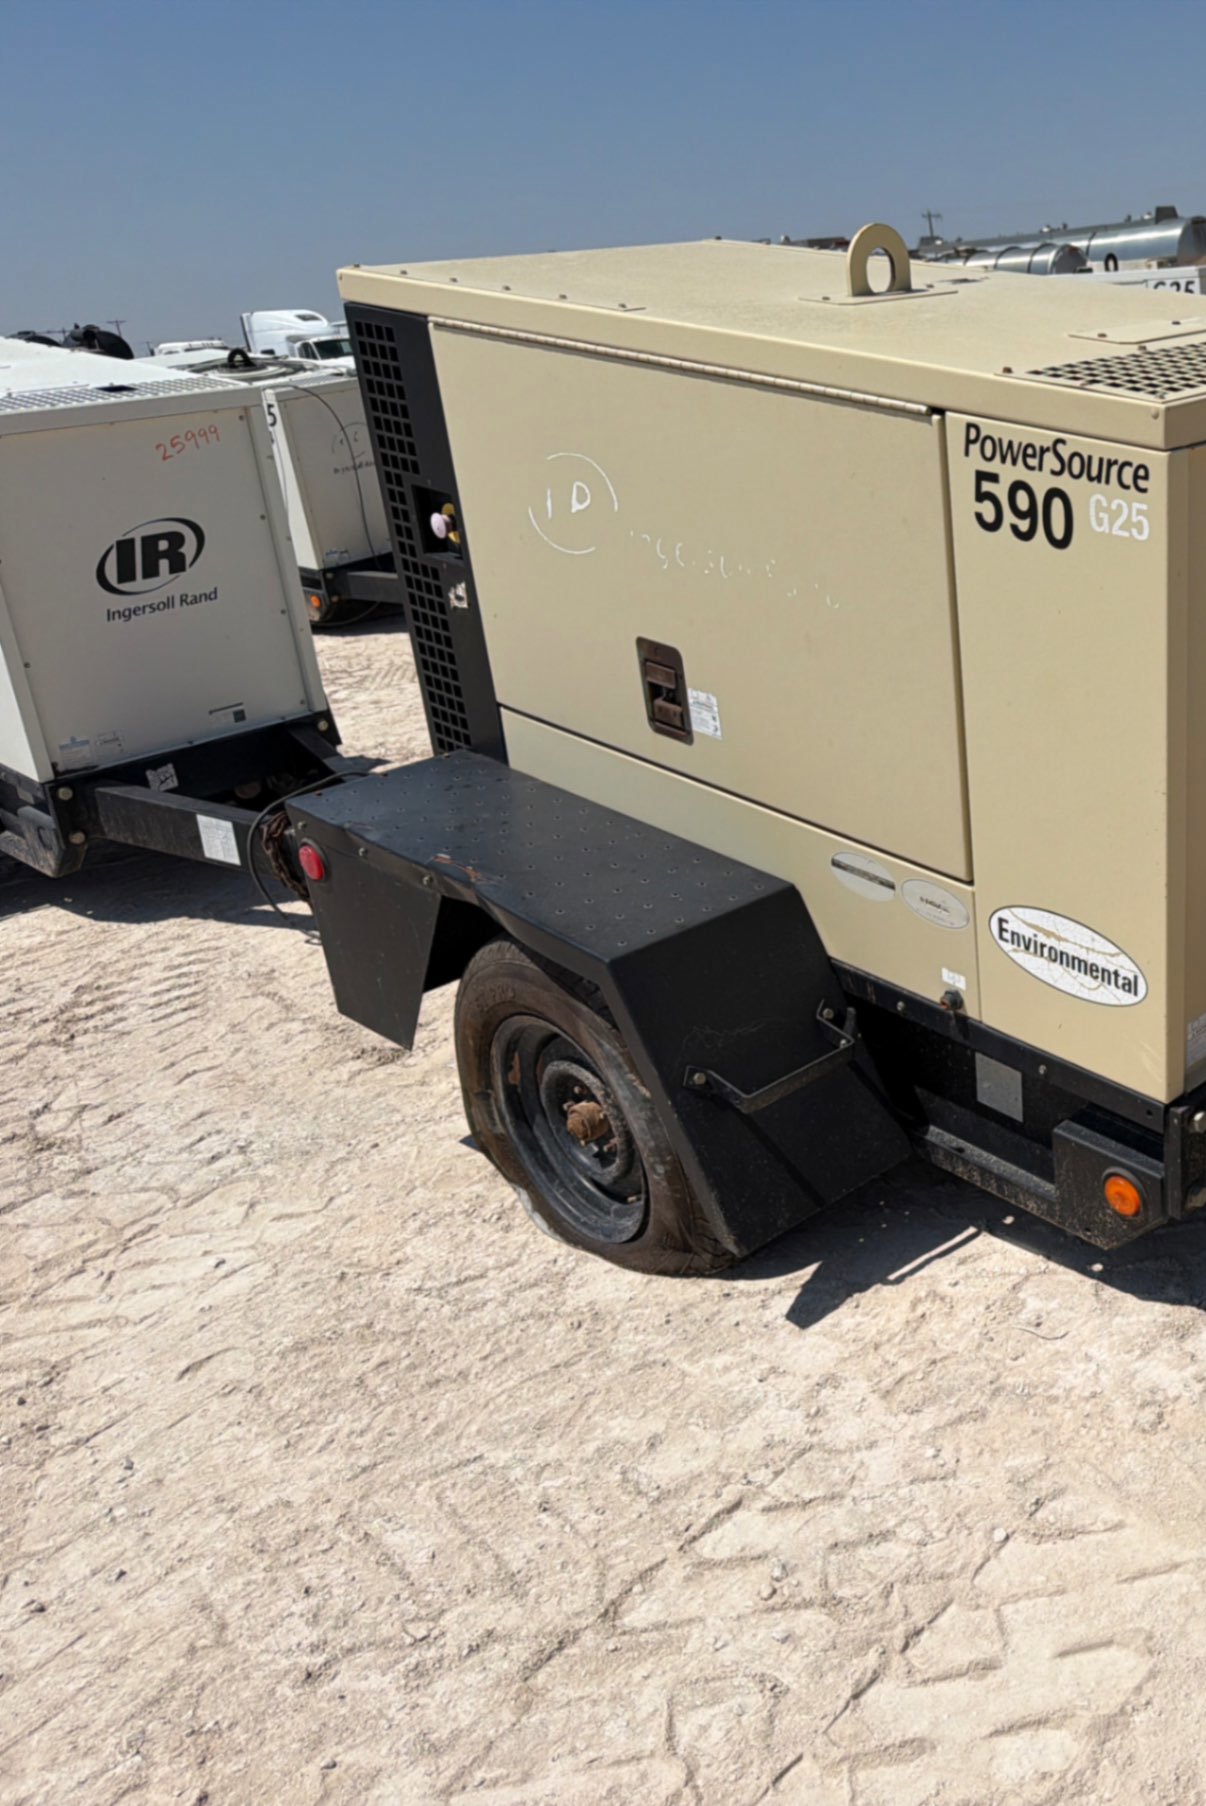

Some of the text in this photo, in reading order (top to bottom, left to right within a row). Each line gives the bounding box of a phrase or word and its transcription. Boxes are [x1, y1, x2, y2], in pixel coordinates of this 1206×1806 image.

[964, 422, 1150, 493] PowerSource
[974, 469, 1150, 550] 590 G25
[114, 530, 187, 585] IR
[106, 587, 219, 624] Ingersoll Rand
[997, 916, 1139, 997] Environmental
